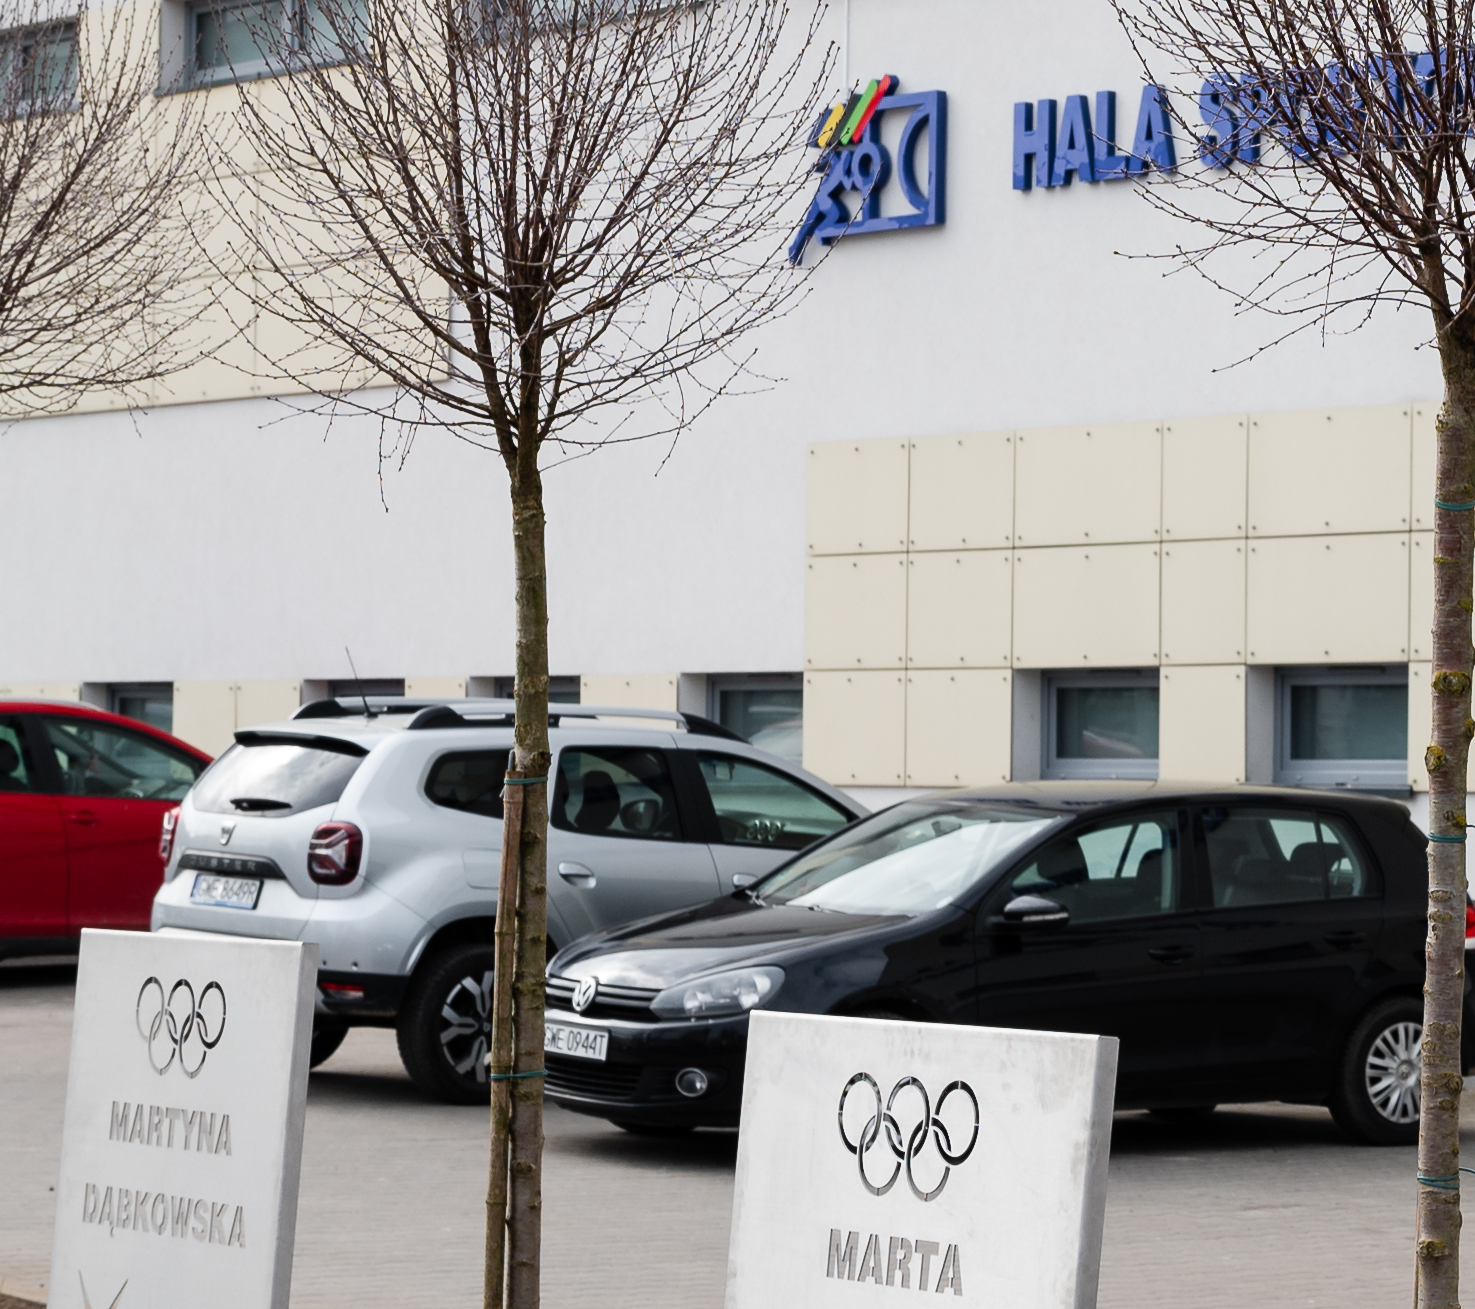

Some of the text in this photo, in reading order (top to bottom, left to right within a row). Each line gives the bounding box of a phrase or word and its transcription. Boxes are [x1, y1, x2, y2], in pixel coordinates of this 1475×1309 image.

[1012, 84, 1178, 191] HALA
[567, 1029, 606, 1057] 0944T
[108, 1100, 233, 1157] MARTYNA
[81, 1182, 247, 1249] DĄBKOWSKA
[825, 1227, 963, 1297] MARTA
